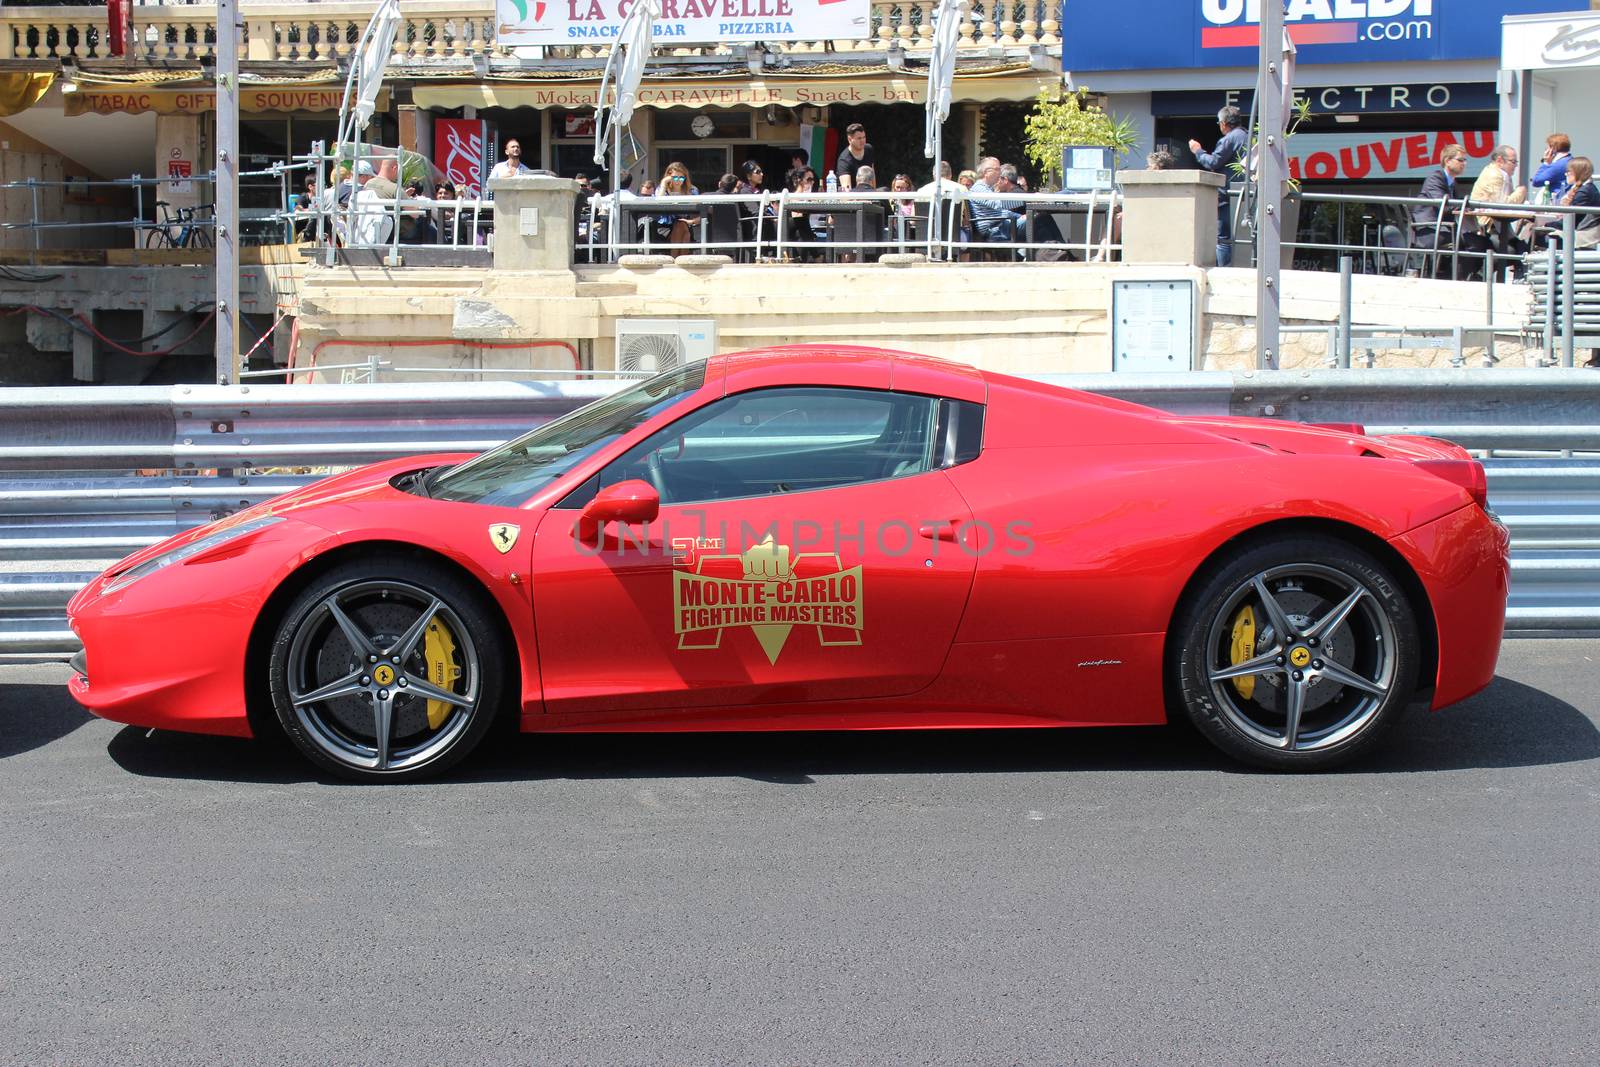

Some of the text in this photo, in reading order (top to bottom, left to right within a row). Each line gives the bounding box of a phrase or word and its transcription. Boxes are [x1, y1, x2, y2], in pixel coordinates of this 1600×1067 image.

[568, 0, 793, 20] LA CRAVELLE
[568, 22, 793, 37] SNACK BAR PIZZERIA
[1360, 21, 1431, 41] .com
[89, 94, 150, 109] TABAC
[638, 88, 782, 104] CARAVELLE
[797, 88, 861, 102] Snack
[883, 86, 919, 100] bar
[1226, 85, 1451, 111] EECTRO
[680, 575, 856, 606] MONTE-CARLO
[681, 605, 856, 630] FIGHTING MASTERS
